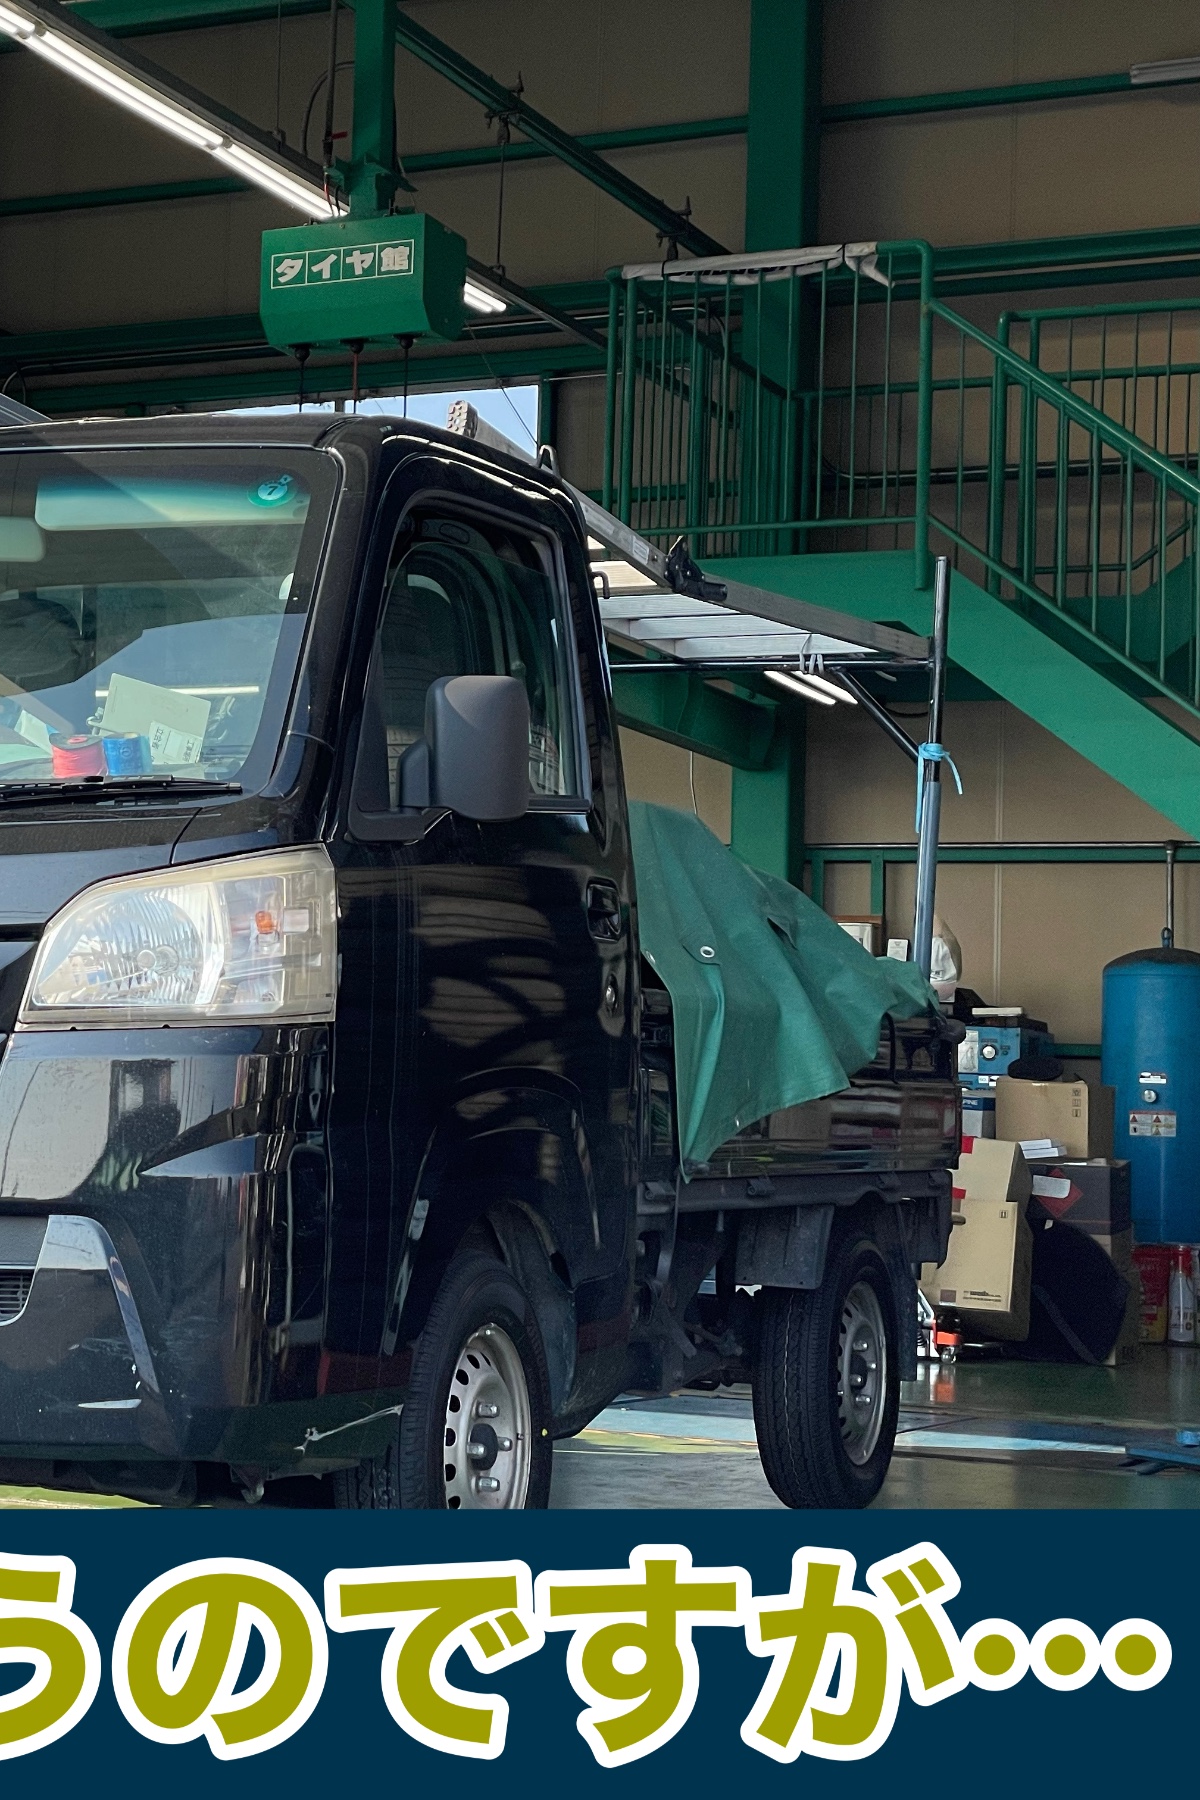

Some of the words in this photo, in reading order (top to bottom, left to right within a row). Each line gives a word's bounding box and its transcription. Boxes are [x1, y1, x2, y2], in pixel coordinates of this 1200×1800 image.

[275, 245, 410, 284] タイヤ館
[266, 485, 279, 496] 7
